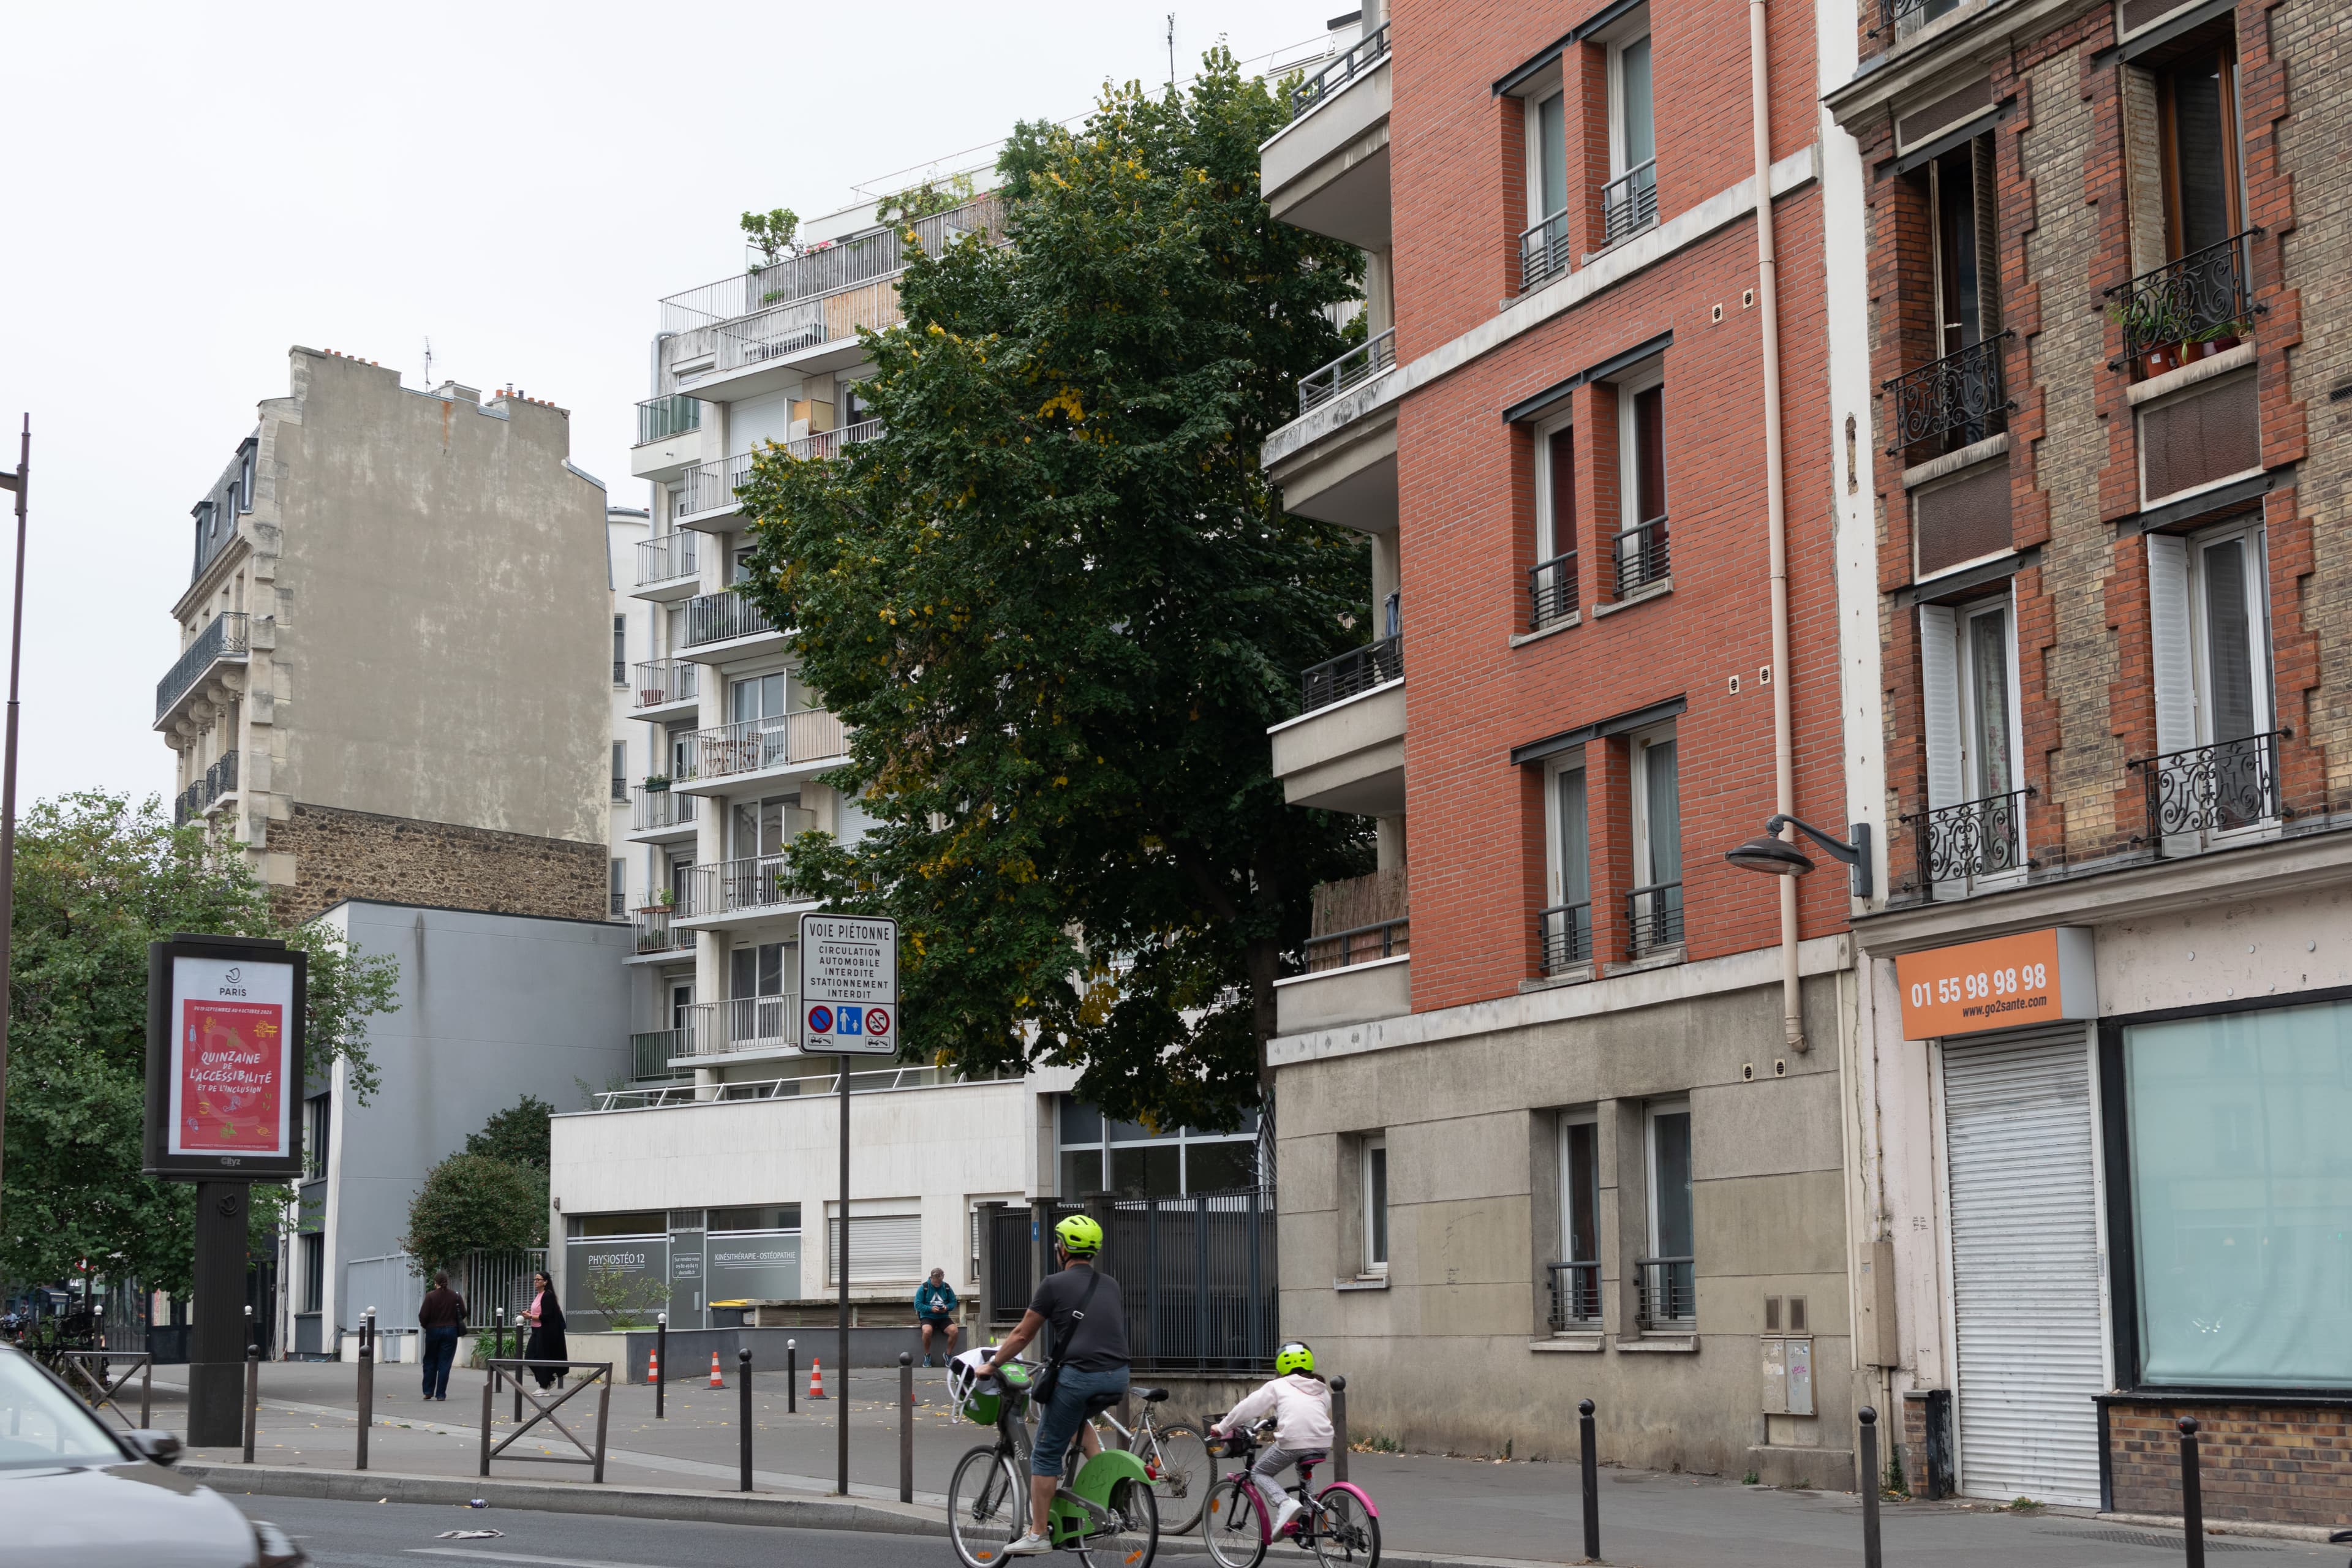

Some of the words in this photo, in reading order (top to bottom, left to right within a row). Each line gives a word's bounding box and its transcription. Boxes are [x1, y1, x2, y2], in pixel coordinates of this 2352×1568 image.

[809, 923, 834, 937] VOIE
[839, 922, 889, 941] PIÉTONNE
[819, 946, 880, 957] CIRCULATION
[820, 957, 880, 967] AUTOMOBILE
[825, 968, 874, 978] INTERDITE
[810, 978, 888, 989] STATIONNEMENT
[1911, 981, 1932, 1008] 01
[1938, 976, 1961, 1004] 55
[1965, 972, 1989, 1000] 98
[1993, 967, 2018, 995] 98
[2022, 963, 2046, 990] 98
[219, 987, 247, 997] PARIS
[827, 989, 872, 998] INTERDIT
[1962, 995, 2047, 1018] www.go2sante.com
[201, 1051, 260, 1065] QUINZAINE
[190, 1068, 273, 1084] L'ACCESSIBILITÉ
[219, 1085, 262, 1094] L'INCLUSION
[588, 1251, 635, 1265] PHYSIOSTÉO
[636, 1253, 645, 1264] 12
[715, 1251, 756, 1261] KINÉSITHÉRAPIE
[760, 1250, 796, 1259] OSTÉOPATHIE
